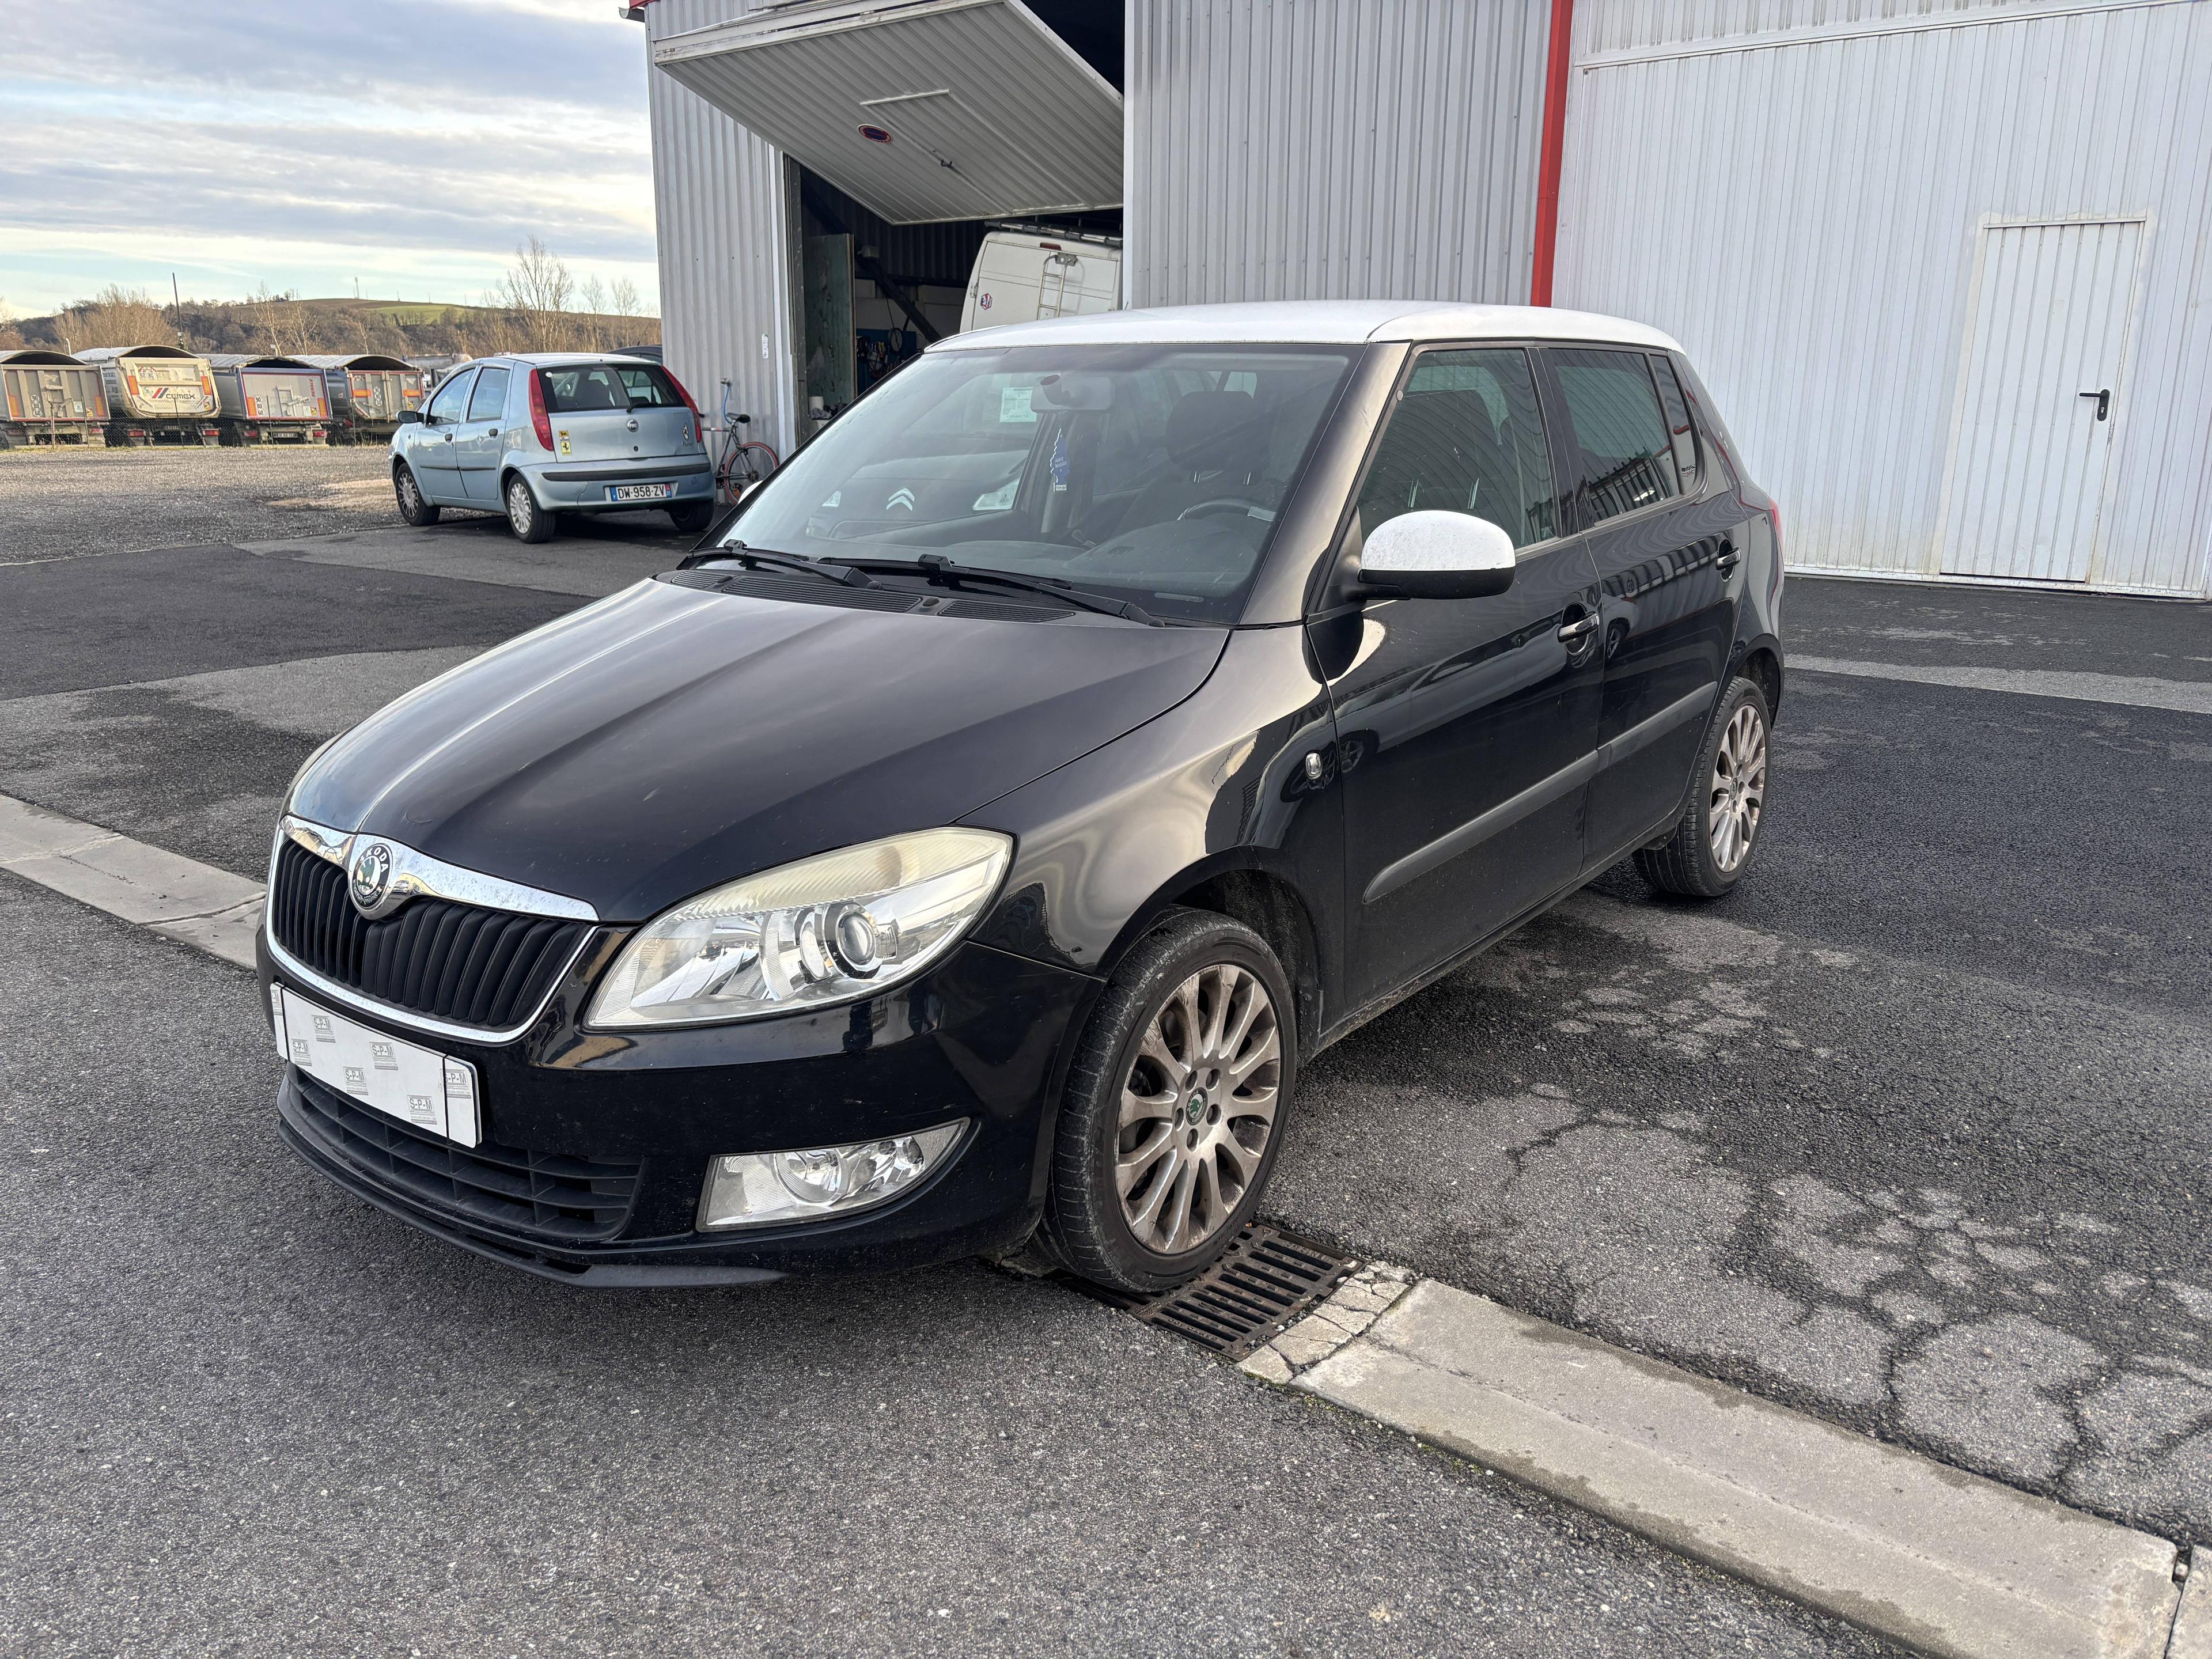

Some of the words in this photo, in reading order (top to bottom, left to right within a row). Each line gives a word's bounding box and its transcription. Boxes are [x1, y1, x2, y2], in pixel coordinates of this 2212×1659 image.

[618, 486, 664, 499] DW-958-ZV
[313, 1018, 331, 1029] S-P-M
[292, 1041, 309, 1052] S-P-M
[372, 1046, 393, 1055] S-P-M
[345, 1070, 365, 1081] S-P-M
[410, 1099, 433, 1110] S-P-M
